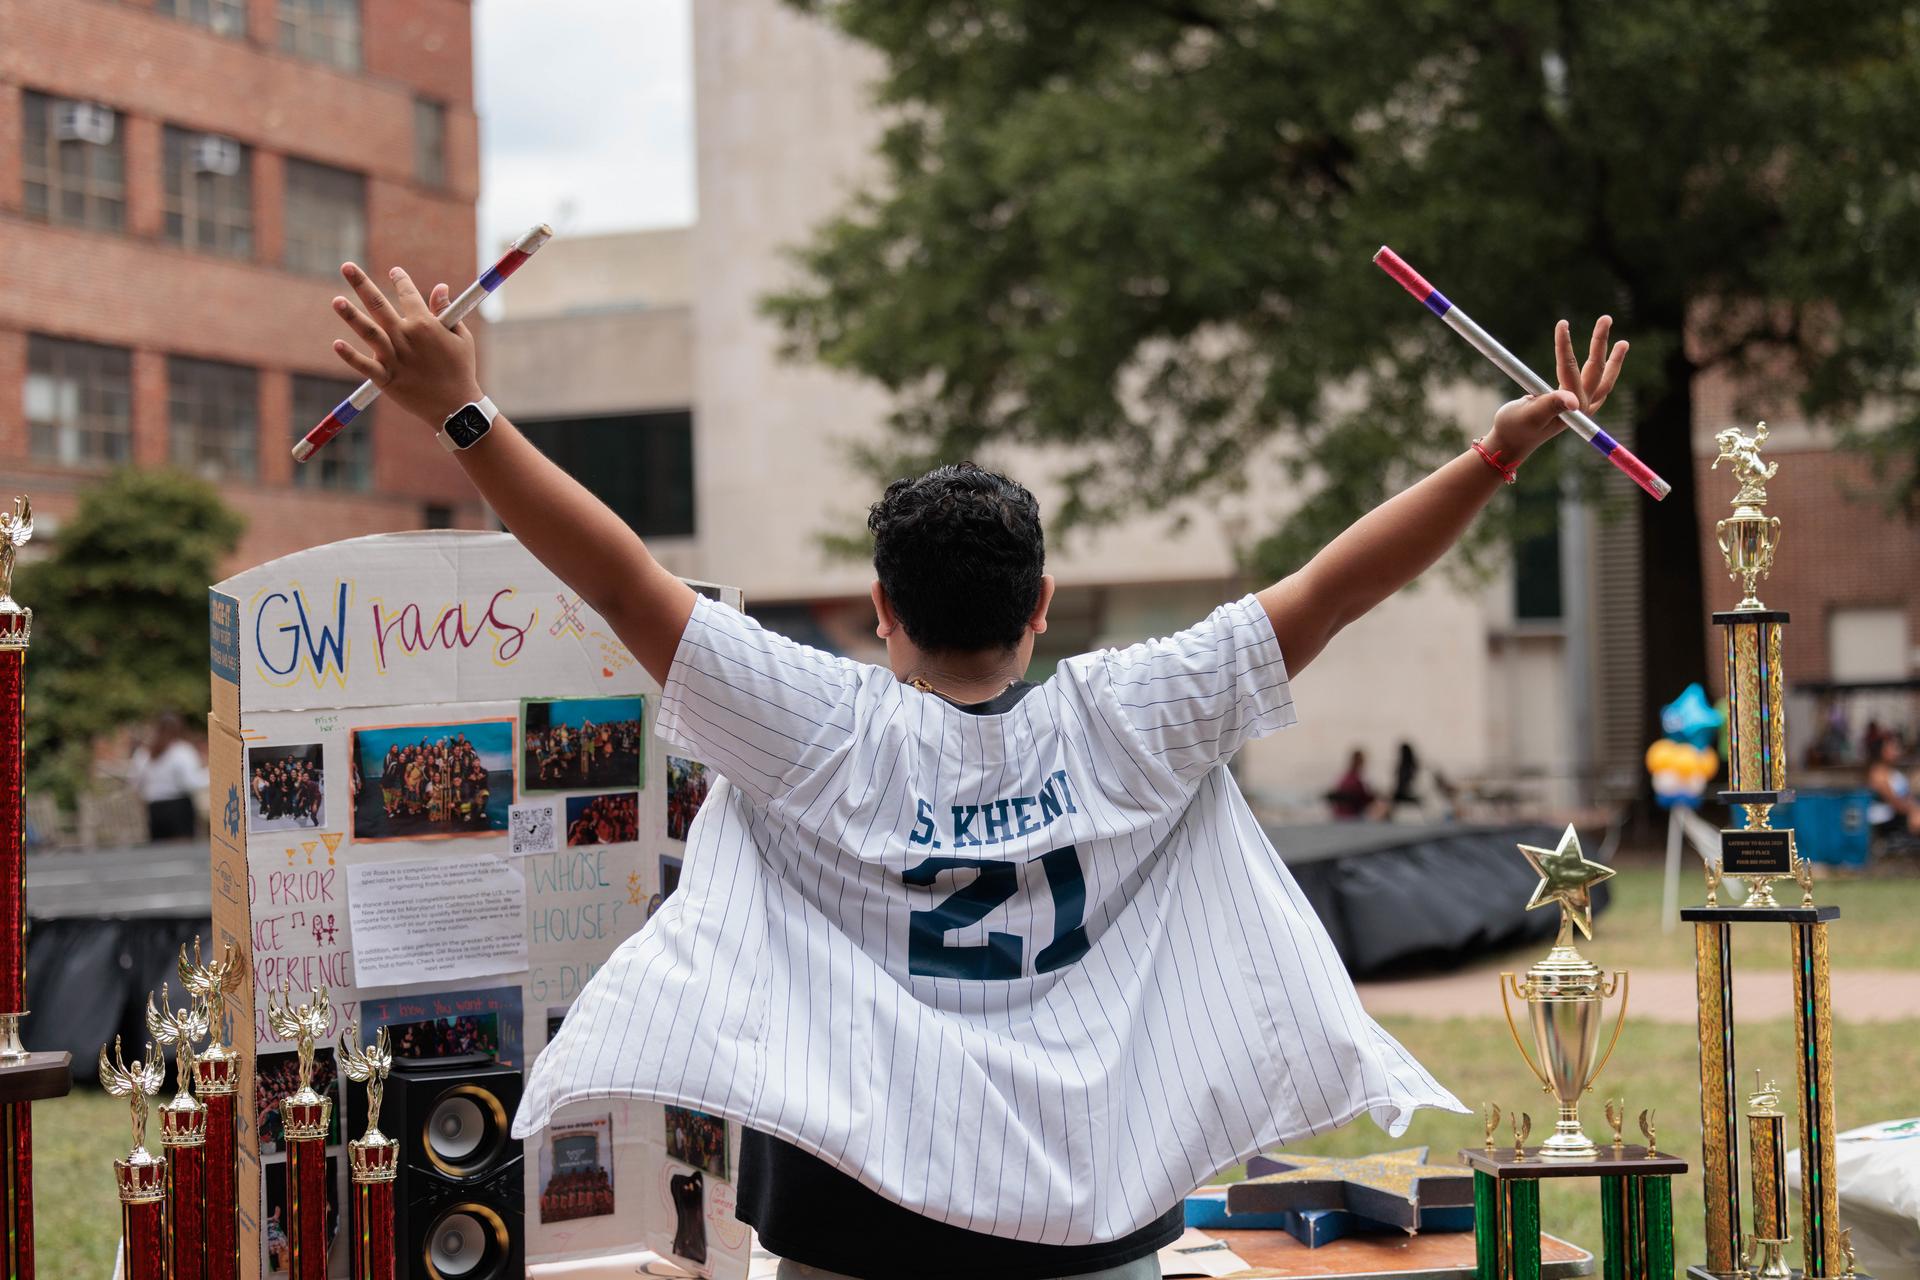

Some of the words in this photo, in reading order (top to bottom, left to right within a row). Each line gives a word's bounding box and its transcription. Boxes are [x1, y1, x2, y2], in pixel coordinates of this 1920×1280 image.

[257, 582, 348, 675] GW
[373, 588, 535, 669] raas
[909, 797, 942, 850] S.
[951, 769, 1078, 849] KHENI
[269, 868, 336, 905] PRIOR
[532, 850, 610, 895] WHOSE
[406, 903, 435, 912] Maryland
[446, 899, 475, 907] California
[533, 901, 623, 944] HOUSE?
[901, 844, 1092, 981] 21
[531, 962, 604, 1002] G-DU
[377, 1004, 388, 1020] I
[399, 1003, 426, 1017] know
[456, 998, 481, 1012] want
